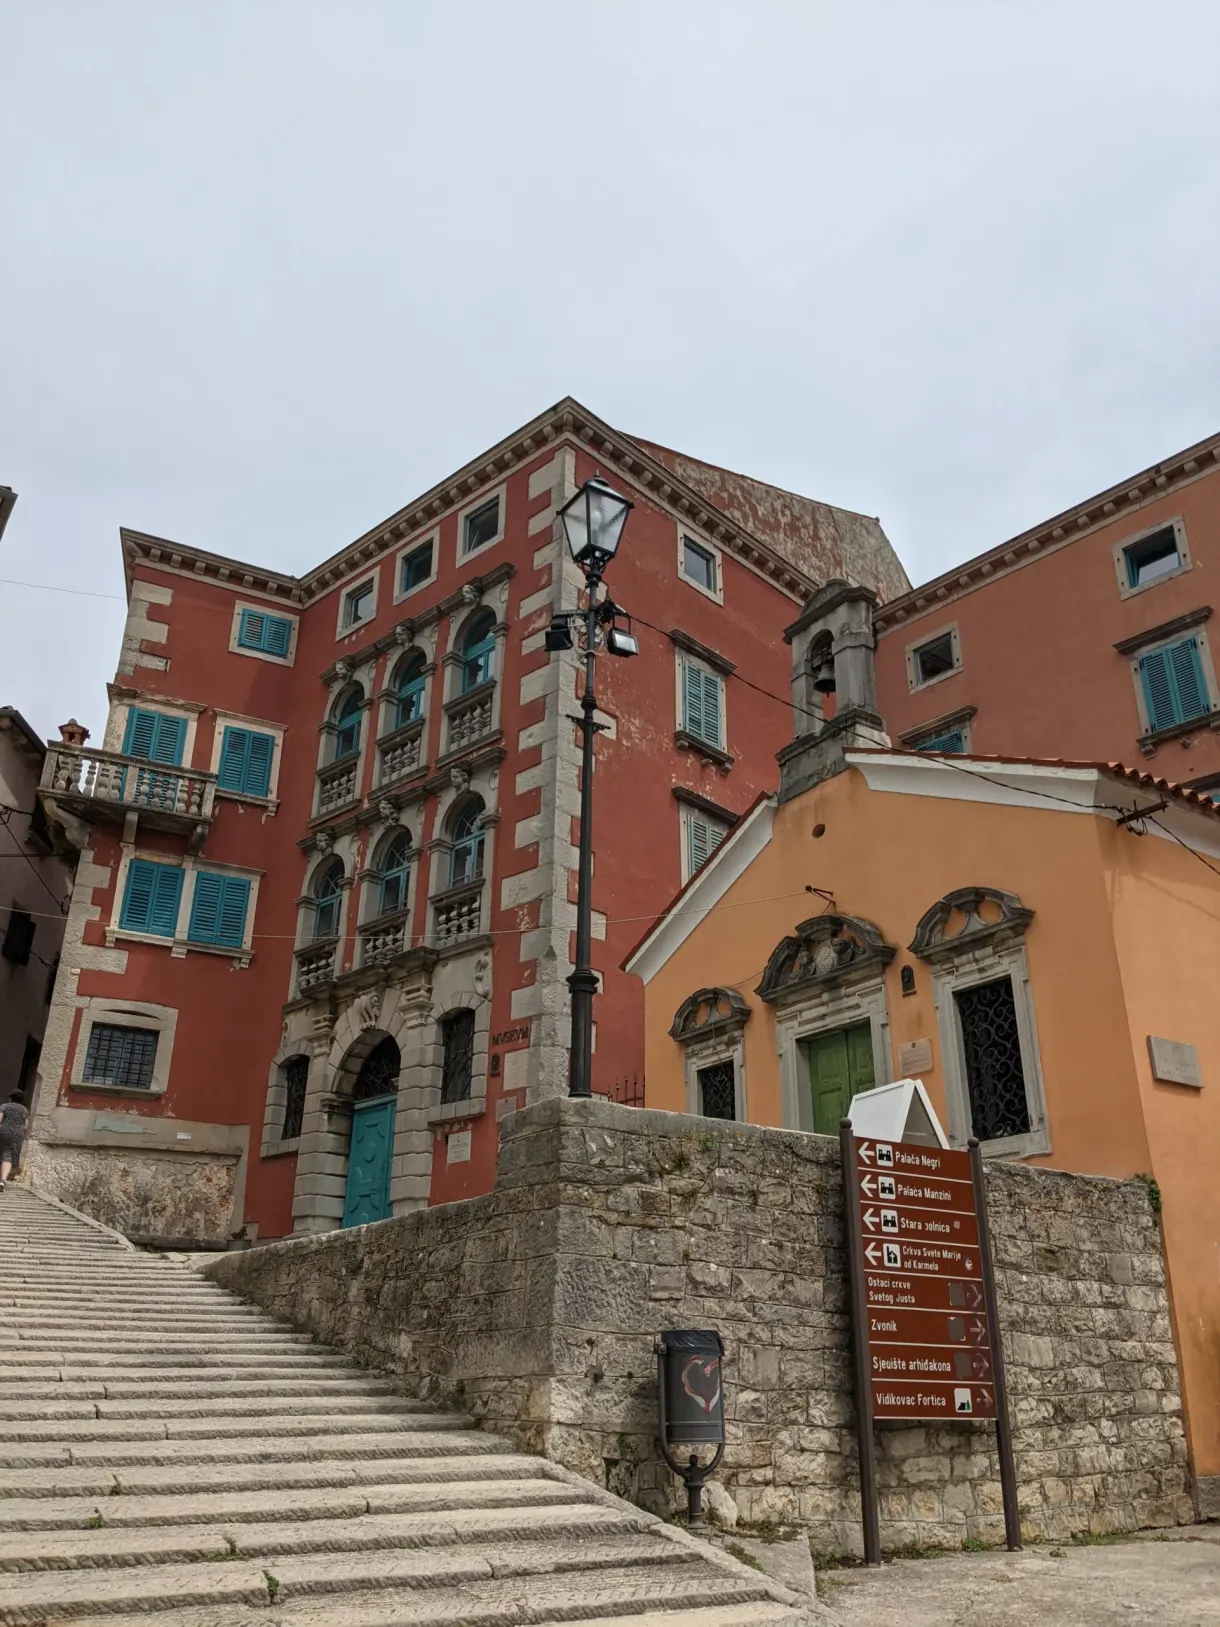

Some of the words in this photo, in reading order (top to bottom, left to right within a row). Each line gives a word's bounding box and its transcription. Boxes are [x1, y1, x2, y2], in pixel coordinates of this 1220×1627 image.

[921, 1155, 941, 1170] Negri
[924, 1187, 952, 1201] Manzini
[900, 1217, 922, 1230] Stara
[902, 1245, 922, 1256] Crkva
[922, 1247, 941, 1258] Svete
[942, 1249, 962, 1262] Marije
[903, 1260, 912, 1269] od
[912, 1260, 939, 1271] Karmela
[868, 1276, 890, 1288] Ostaci
[869, 1290, 894, 1305] Svetog
[896, 1293, 916, 1304] Justa
[871, 1319, 898, 1332] Zvonik
[876, 1392, 916, 1406] Vidikovac
[917, 1393, 947, 1407] Fortica
